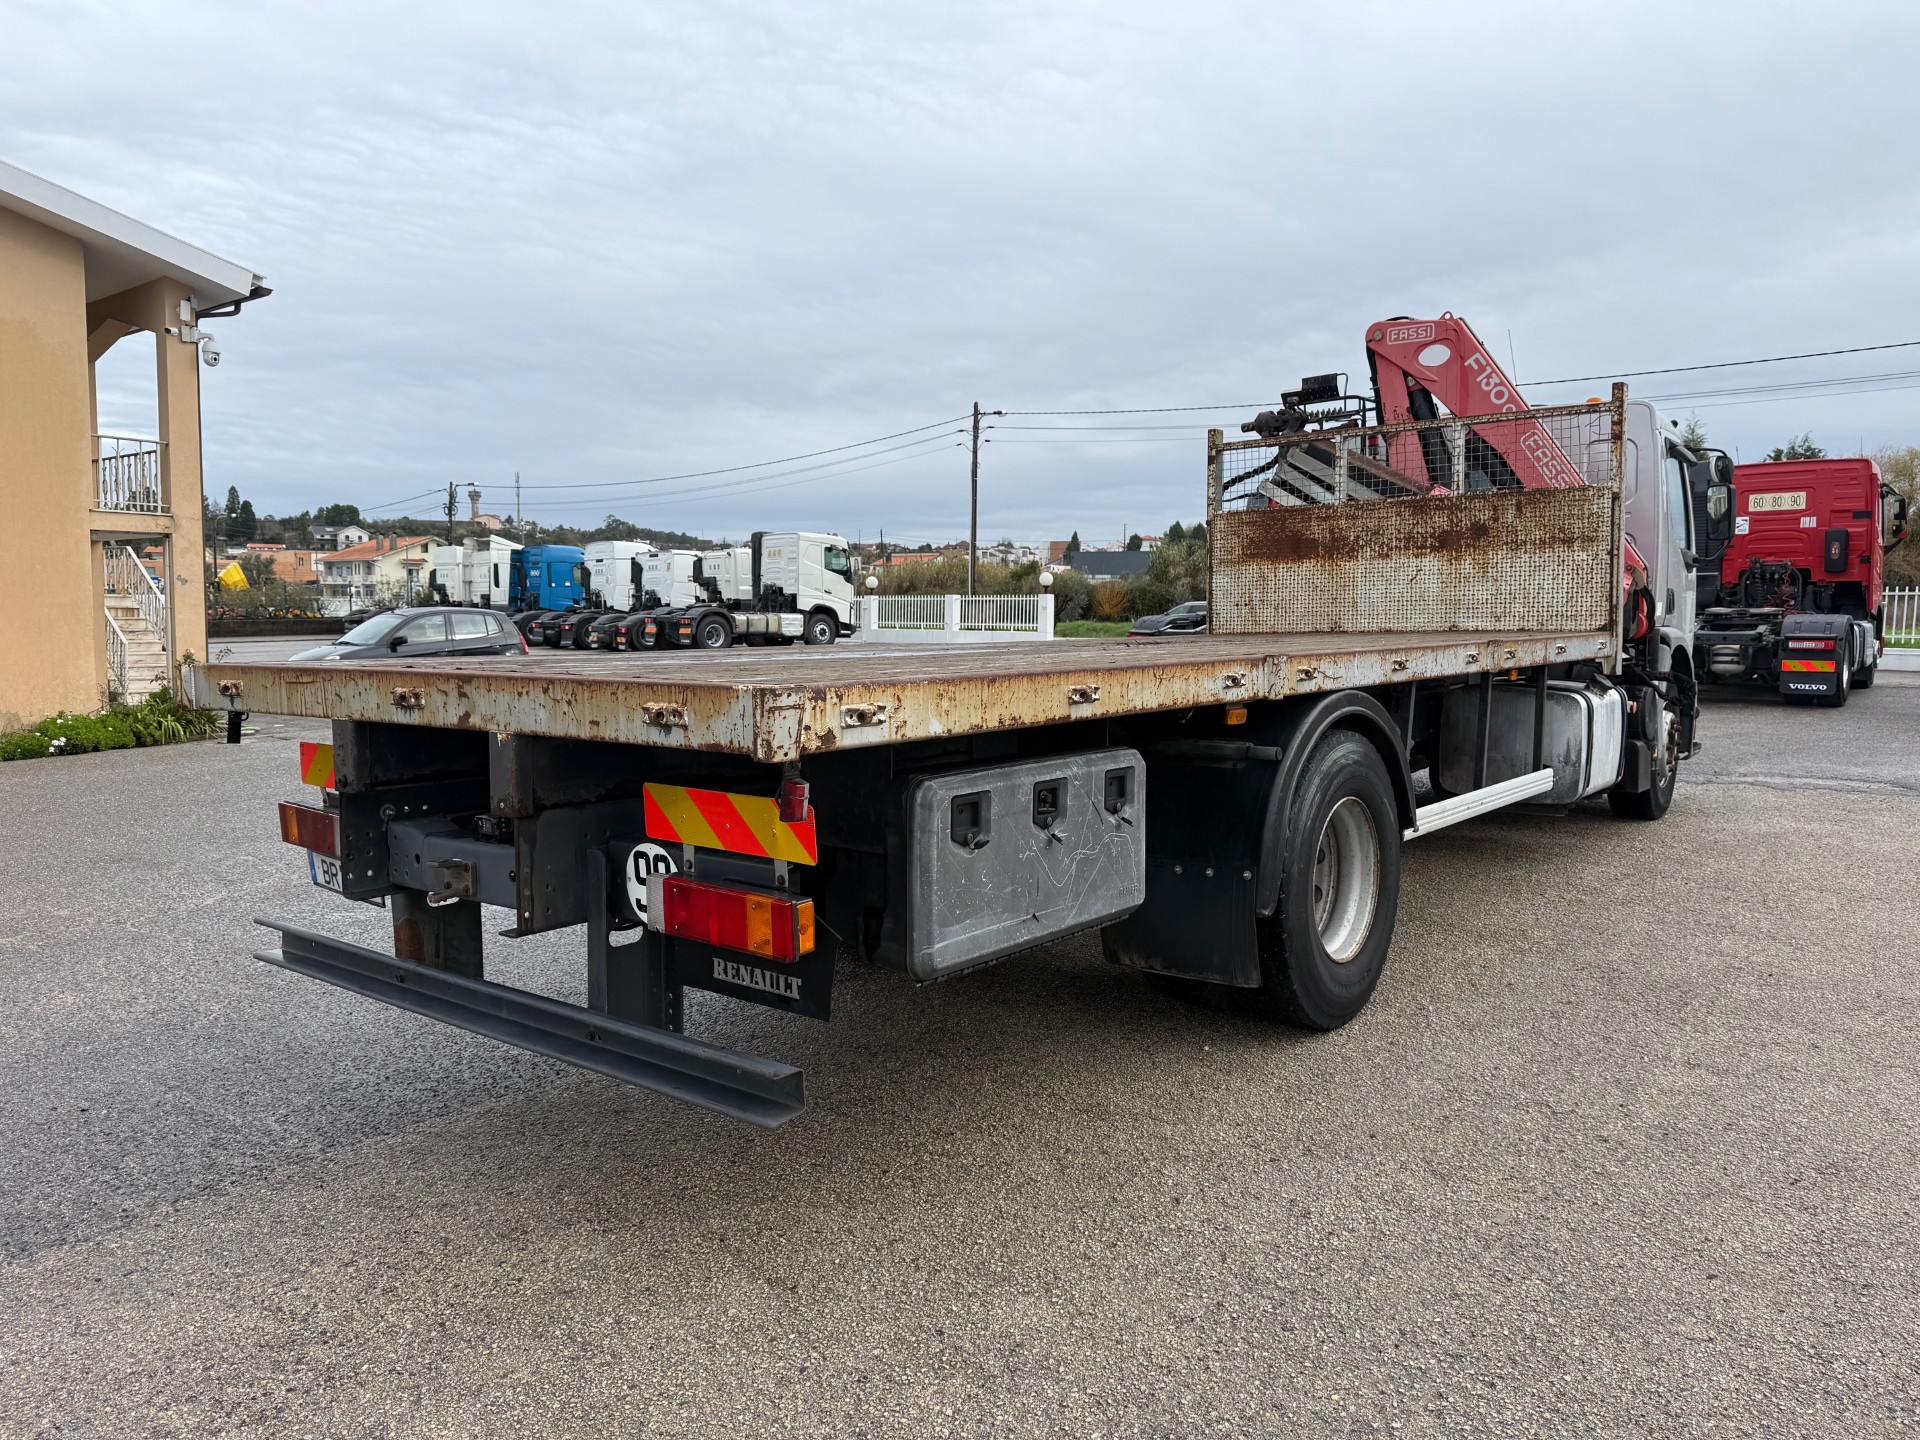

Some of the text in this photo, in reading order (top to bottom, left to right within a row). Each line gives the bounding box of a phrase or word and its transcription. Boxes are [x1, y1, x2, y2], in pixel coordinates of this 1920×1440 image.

[1391, 327, 1431, 341] FASSI
[1525, 434, 1571, 489] FASS
[1753, 495, 1801, 509] 60 80 90
[320, 858, 341, 889] BR
[712, 957, 802, 1000] RENAULT
